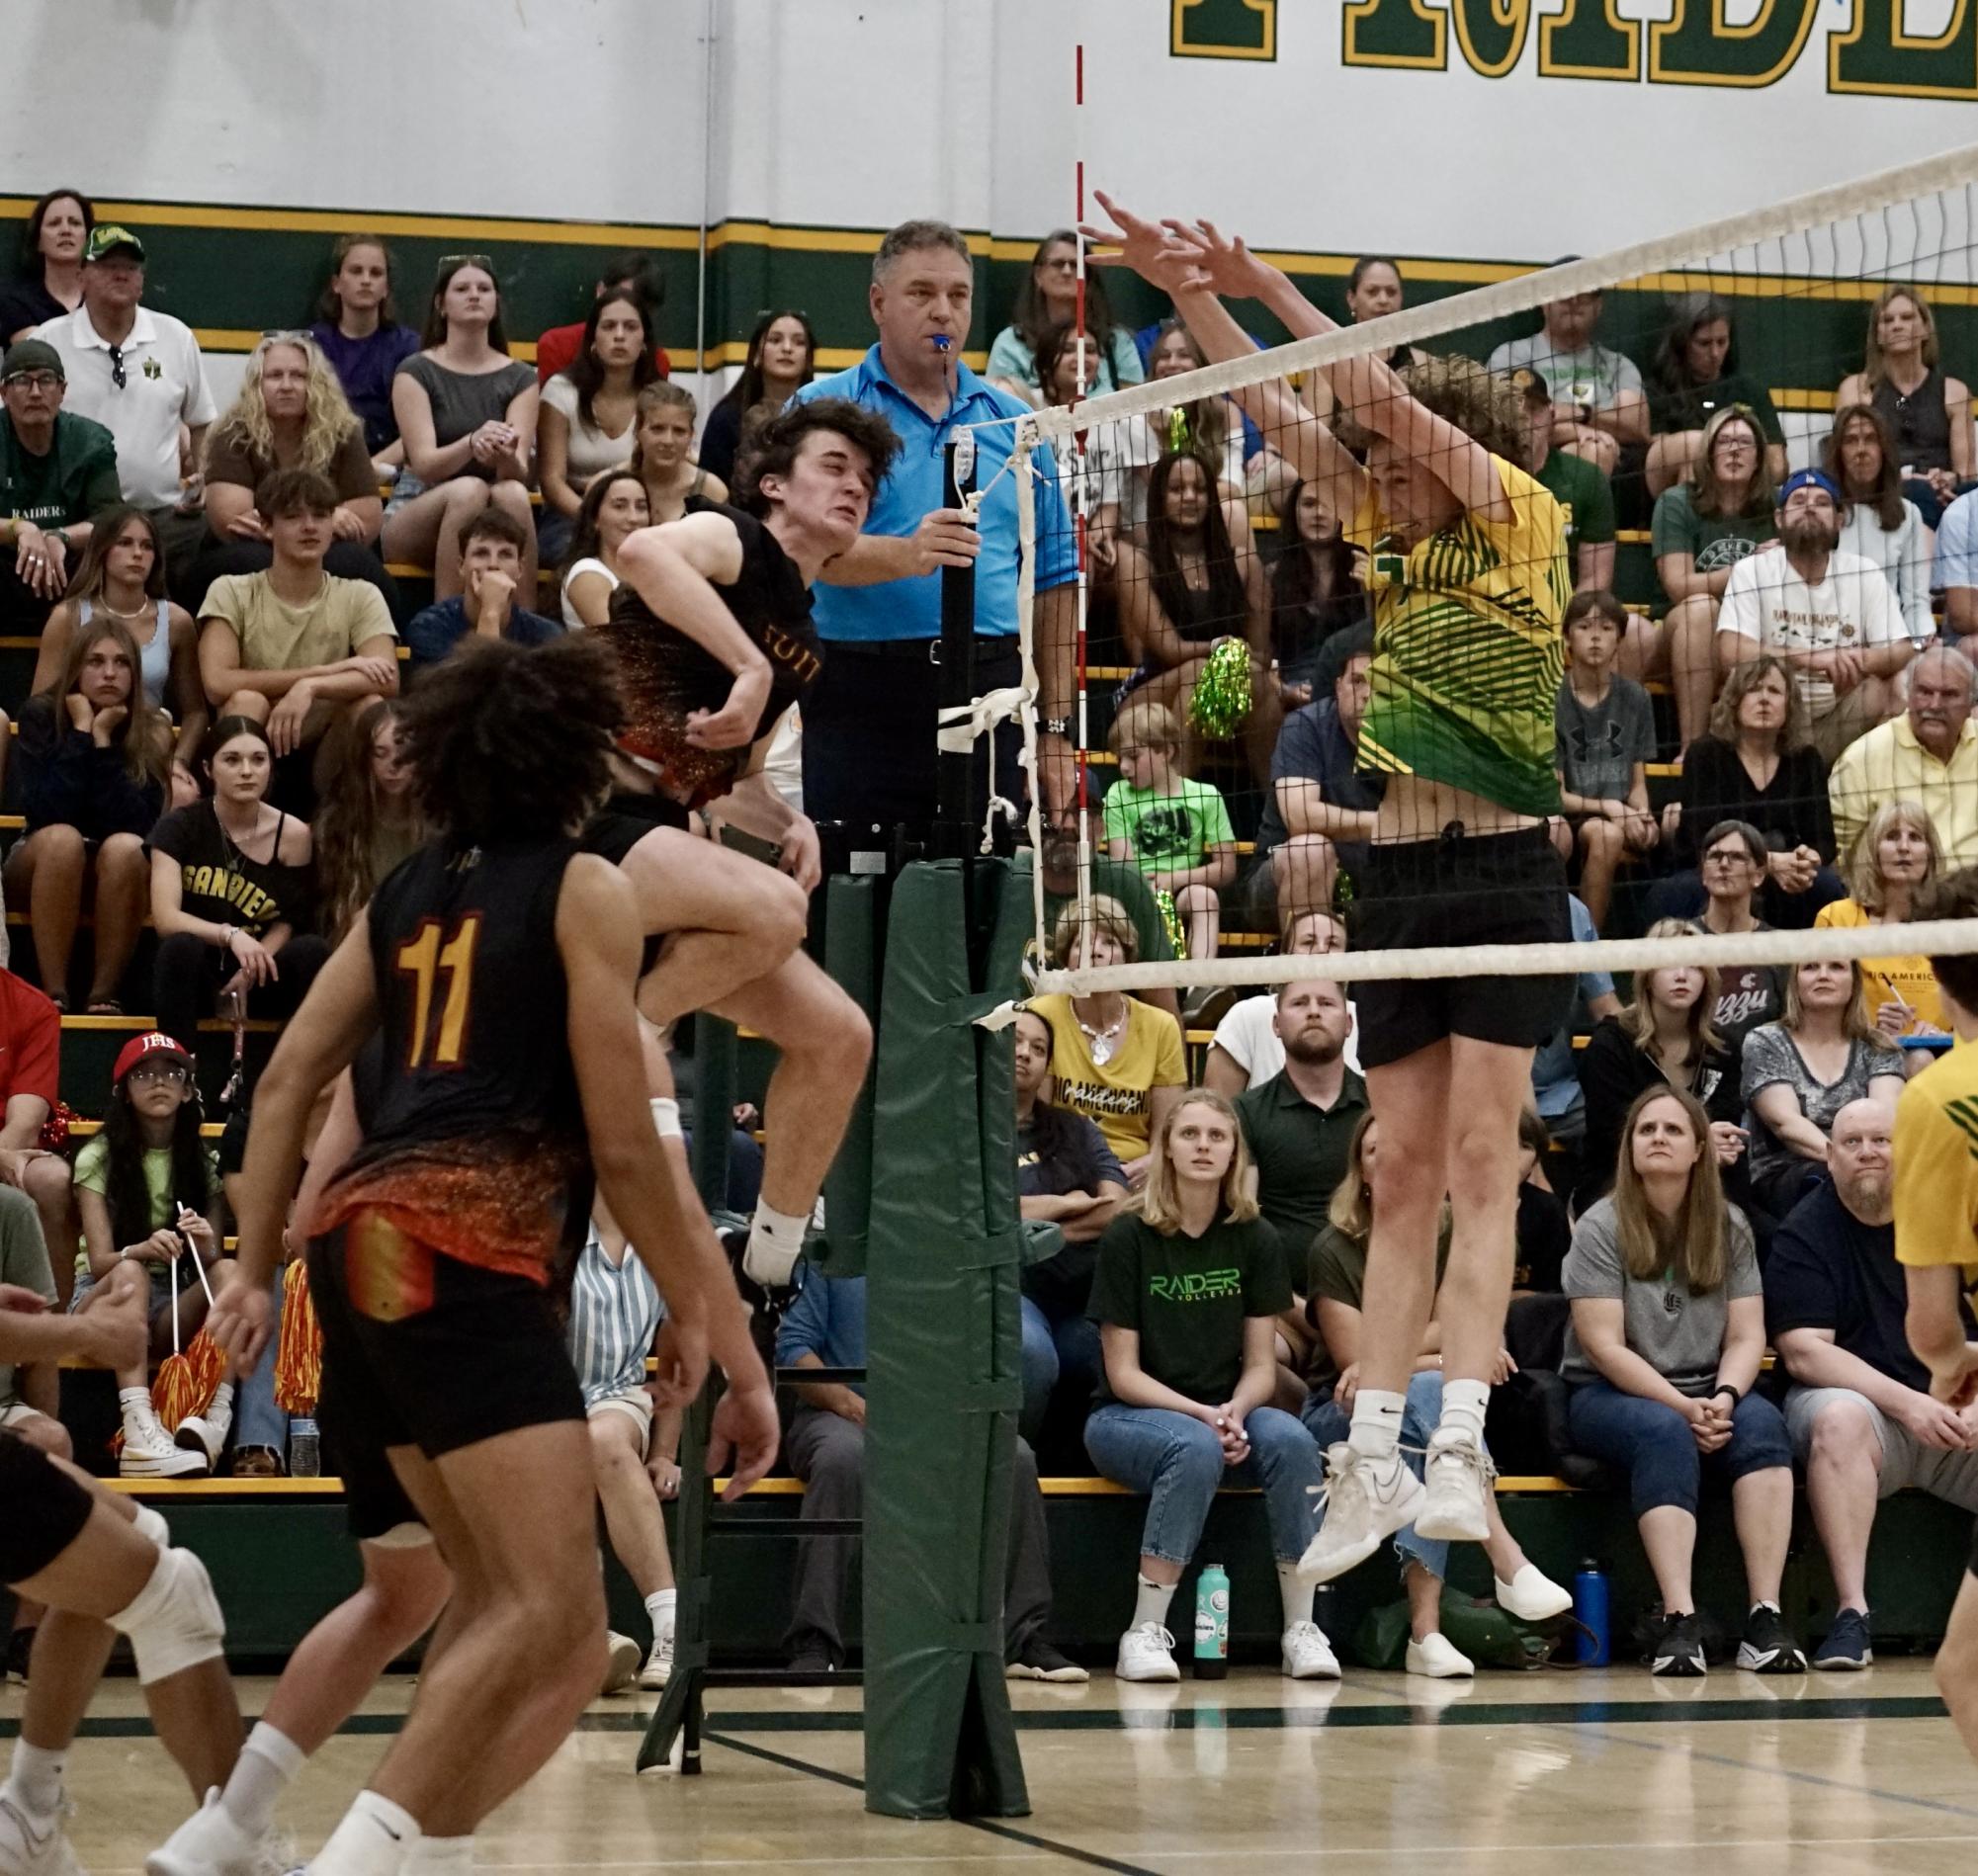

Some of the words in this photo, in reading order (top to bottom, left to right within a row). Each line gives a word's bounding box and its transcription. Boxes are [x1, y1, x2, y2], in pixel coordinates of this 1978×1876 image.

[394, 913, 482, 1073] 11
[141, 1032, 176, 1053] JHS
[1150, 1268, 1241, 1301] RAIDER
